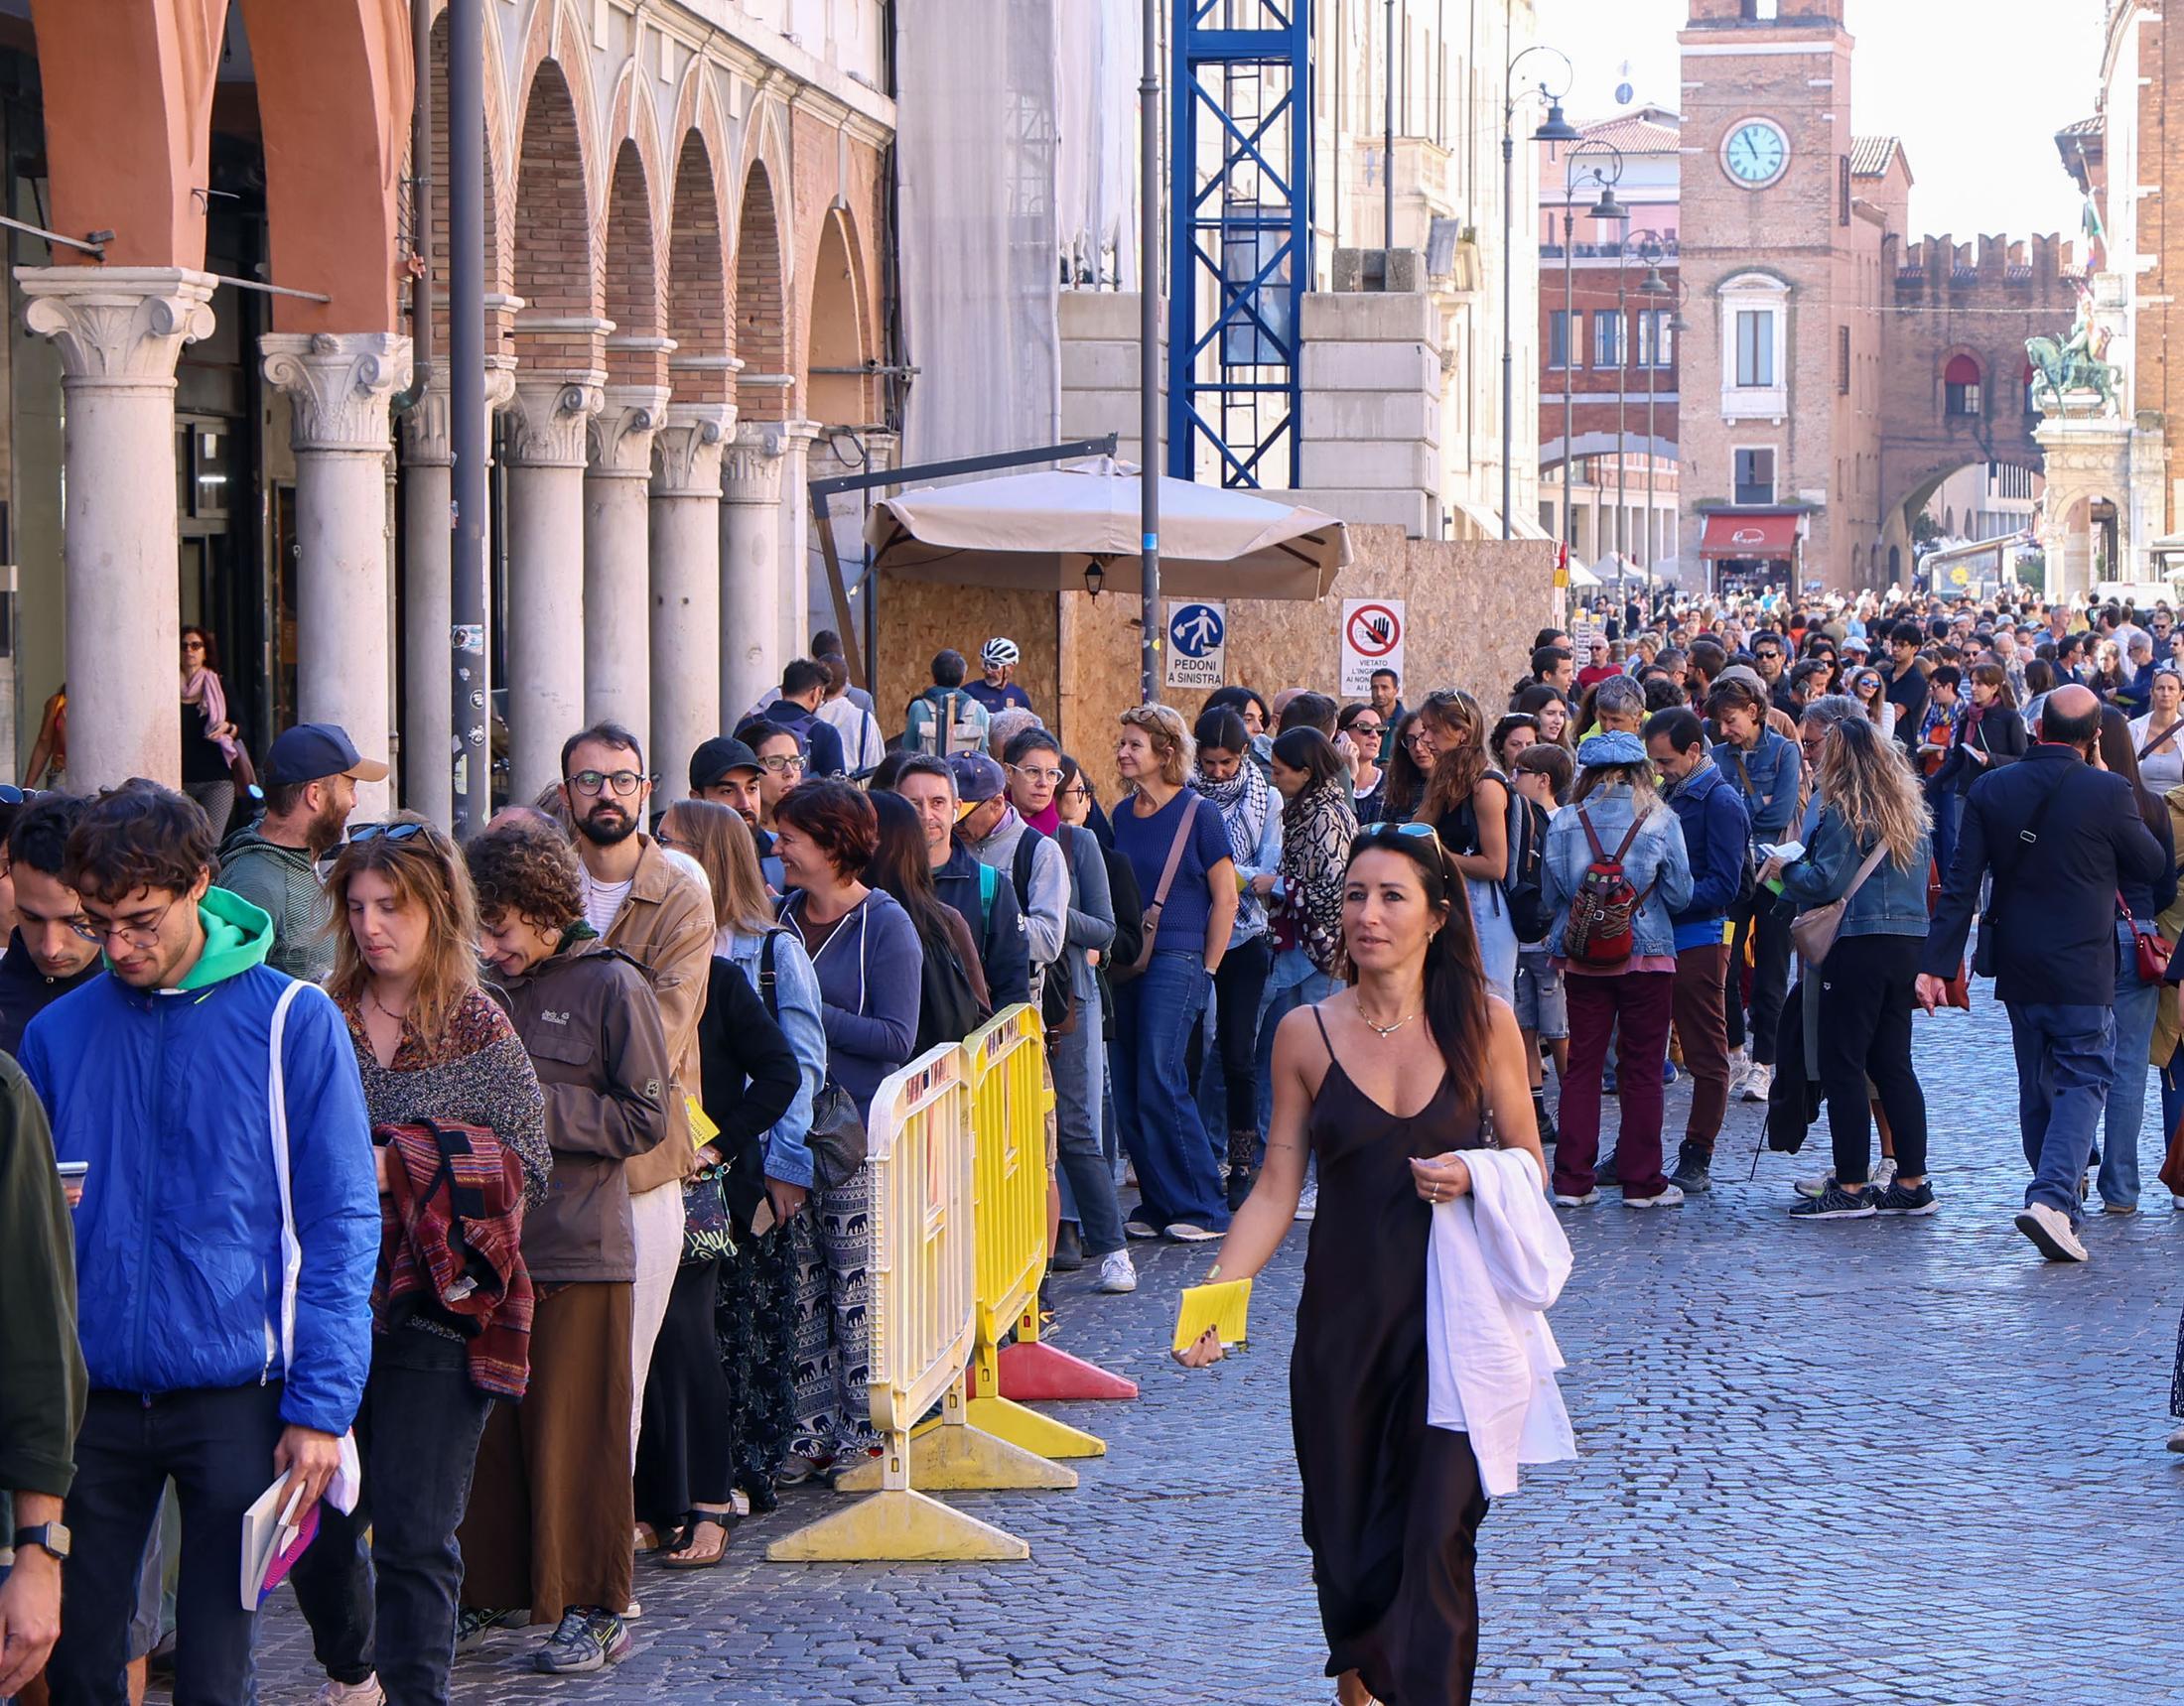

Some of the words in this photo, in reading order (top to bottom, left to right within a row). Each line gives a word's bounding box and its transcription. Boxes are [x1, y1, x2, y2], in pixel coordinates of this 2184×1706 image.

[1174, 659, 1216, 671] PEDONI
[1167, 672, 1175, 683] A
[1177, 672, 1222, 684] SINISTRA
